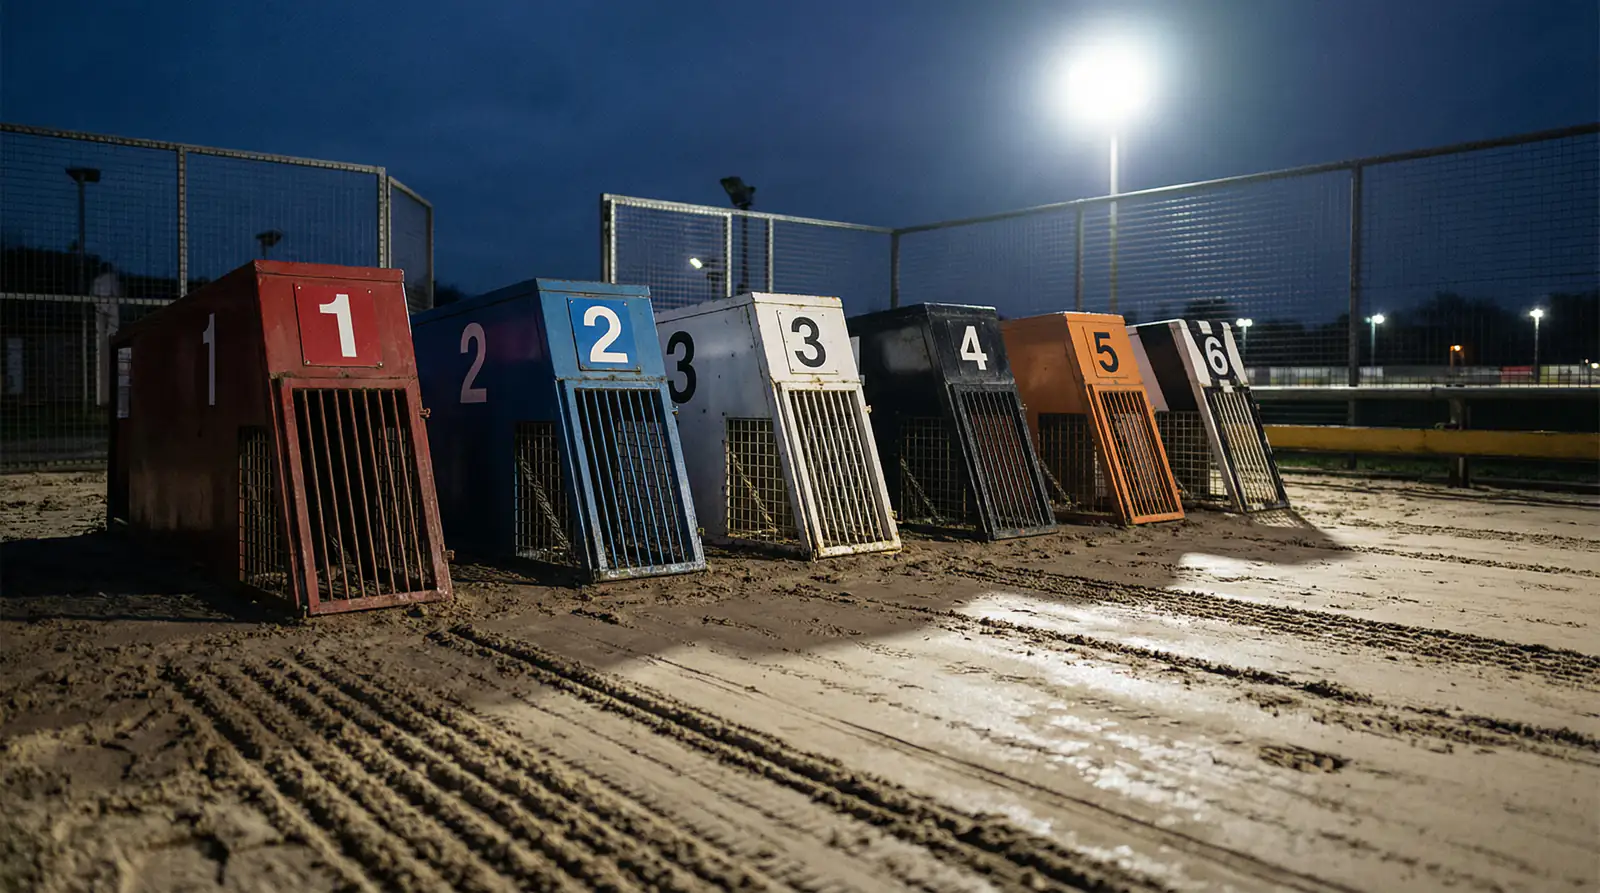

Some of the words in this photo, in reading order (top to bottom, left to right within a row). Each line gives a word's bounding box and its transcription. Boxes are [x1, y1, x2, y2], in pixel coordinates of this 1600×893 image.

[319, 293, 358, 358] 1
[583, 305, 629, 364] 2
[790, 316, 827, 368] 3
[959, 325, 989, 371] 4
[1093, 331, 1119, 374] 5
[202, 312, 216, 406] 1
[459, 322, 488, 404] 2
[666, 330, 697, 404] 3
[1204, 336, 1229, 376] 6
